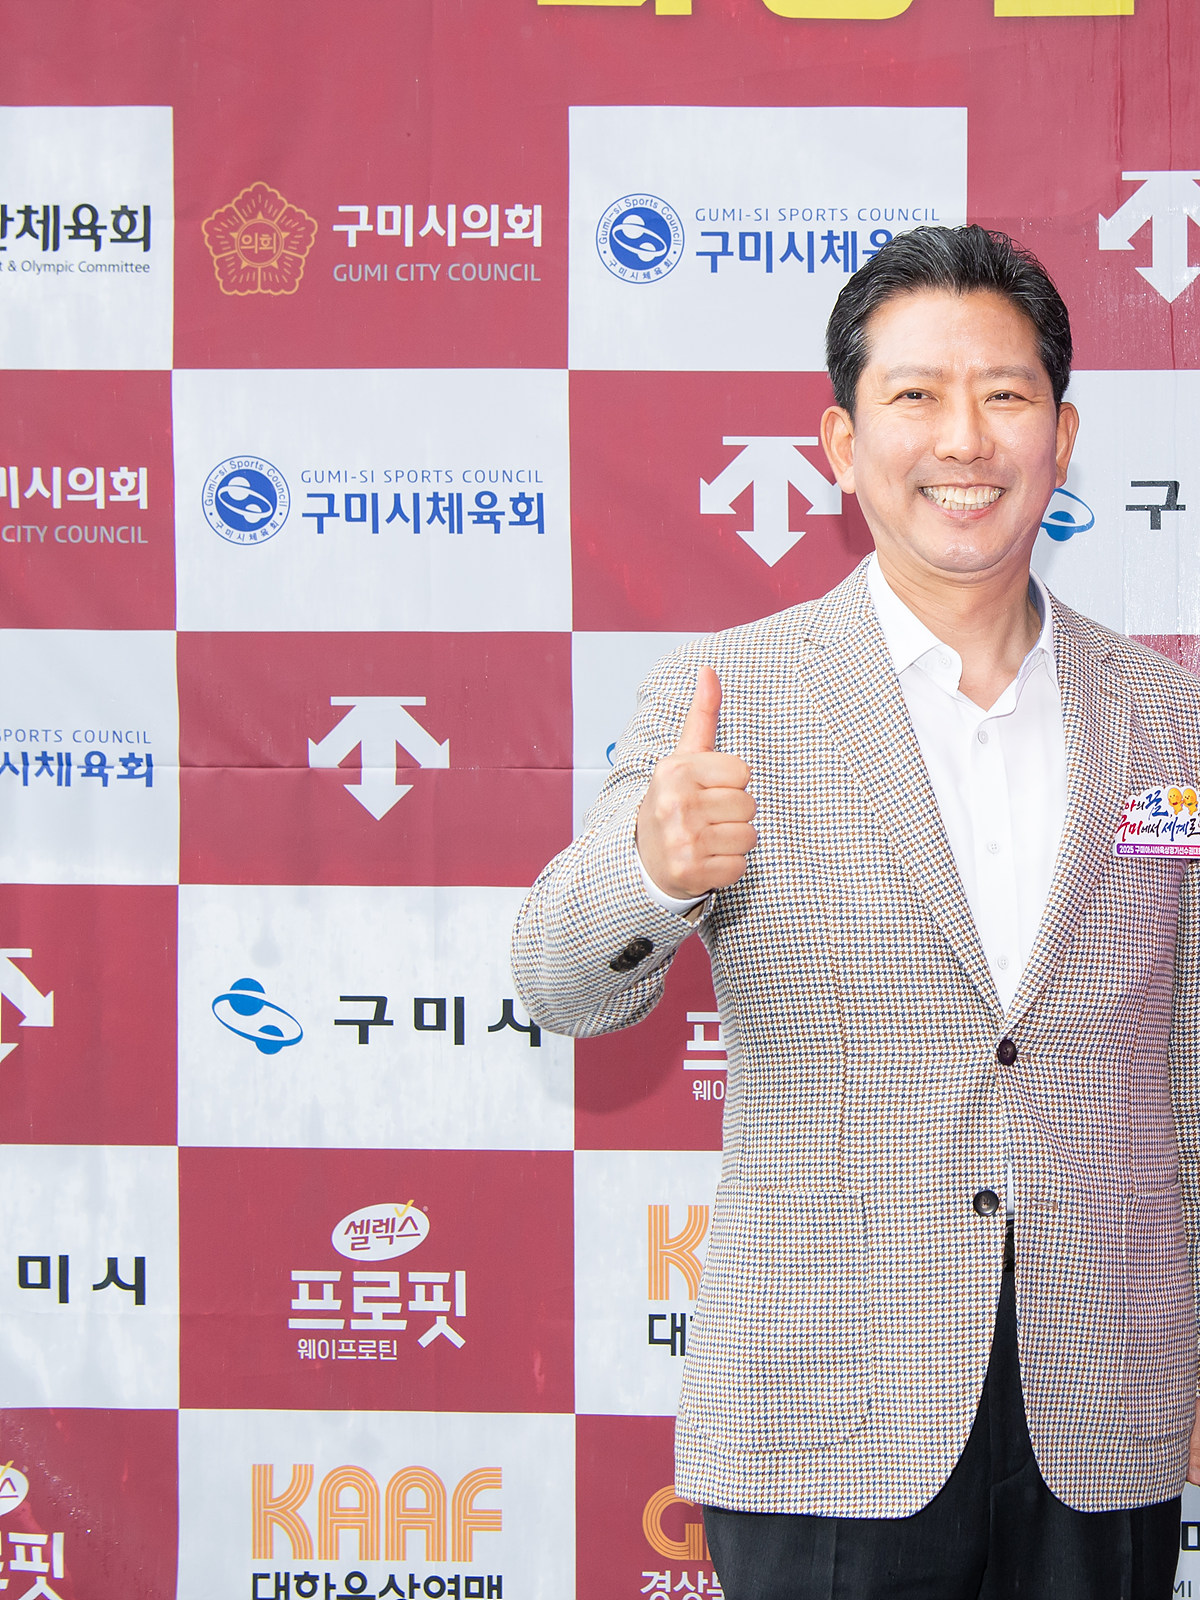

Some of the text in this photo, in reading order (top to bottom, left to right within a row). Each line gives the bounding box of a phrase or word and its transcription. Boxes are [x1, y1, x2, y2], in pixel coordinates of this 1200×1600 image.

[332, 204, 542, 248] 구미시의회
[624, 199, 659, 210] Sports
[661, 206, 682, 246] Council
[695, 208, 941, 222] GUMI-SI SPORTS COUNCIL
[240, 232, 277, 254] 의회
[21, 260, 75, 275] Olympic
[78, 261, 151, 273] Committee
[333, 263, 542, 282] GUMI CITY COUNCIL
[229, 460, 265, 470] Sports
[266, 468, 288, 508] Council
[301, 470, 544, 483] GUMI-SI SPORTS COUNCIL
[302, 491, 545, 534] 구미시체육회
[1, 525, 149, 544] CITY COUNCIL
[0, 728, 152, 744] PORTS COUNCIL
[0, 750, 153, 788] 시체육회
[1119, 844, 1135, 854] 2025
[344, 1216, 421, 1251] 셀렉스
[288, 1270, 466, 1348] 프로핏
[298, 1339, 398, 1361] 웨이프로틴
[648, 1313, 693, 1356] 대
[252, 1464, 503, 1563] KAAF
[642, 1484, 712, 1561] G
[0, 1531, 64, 1600] 핏
